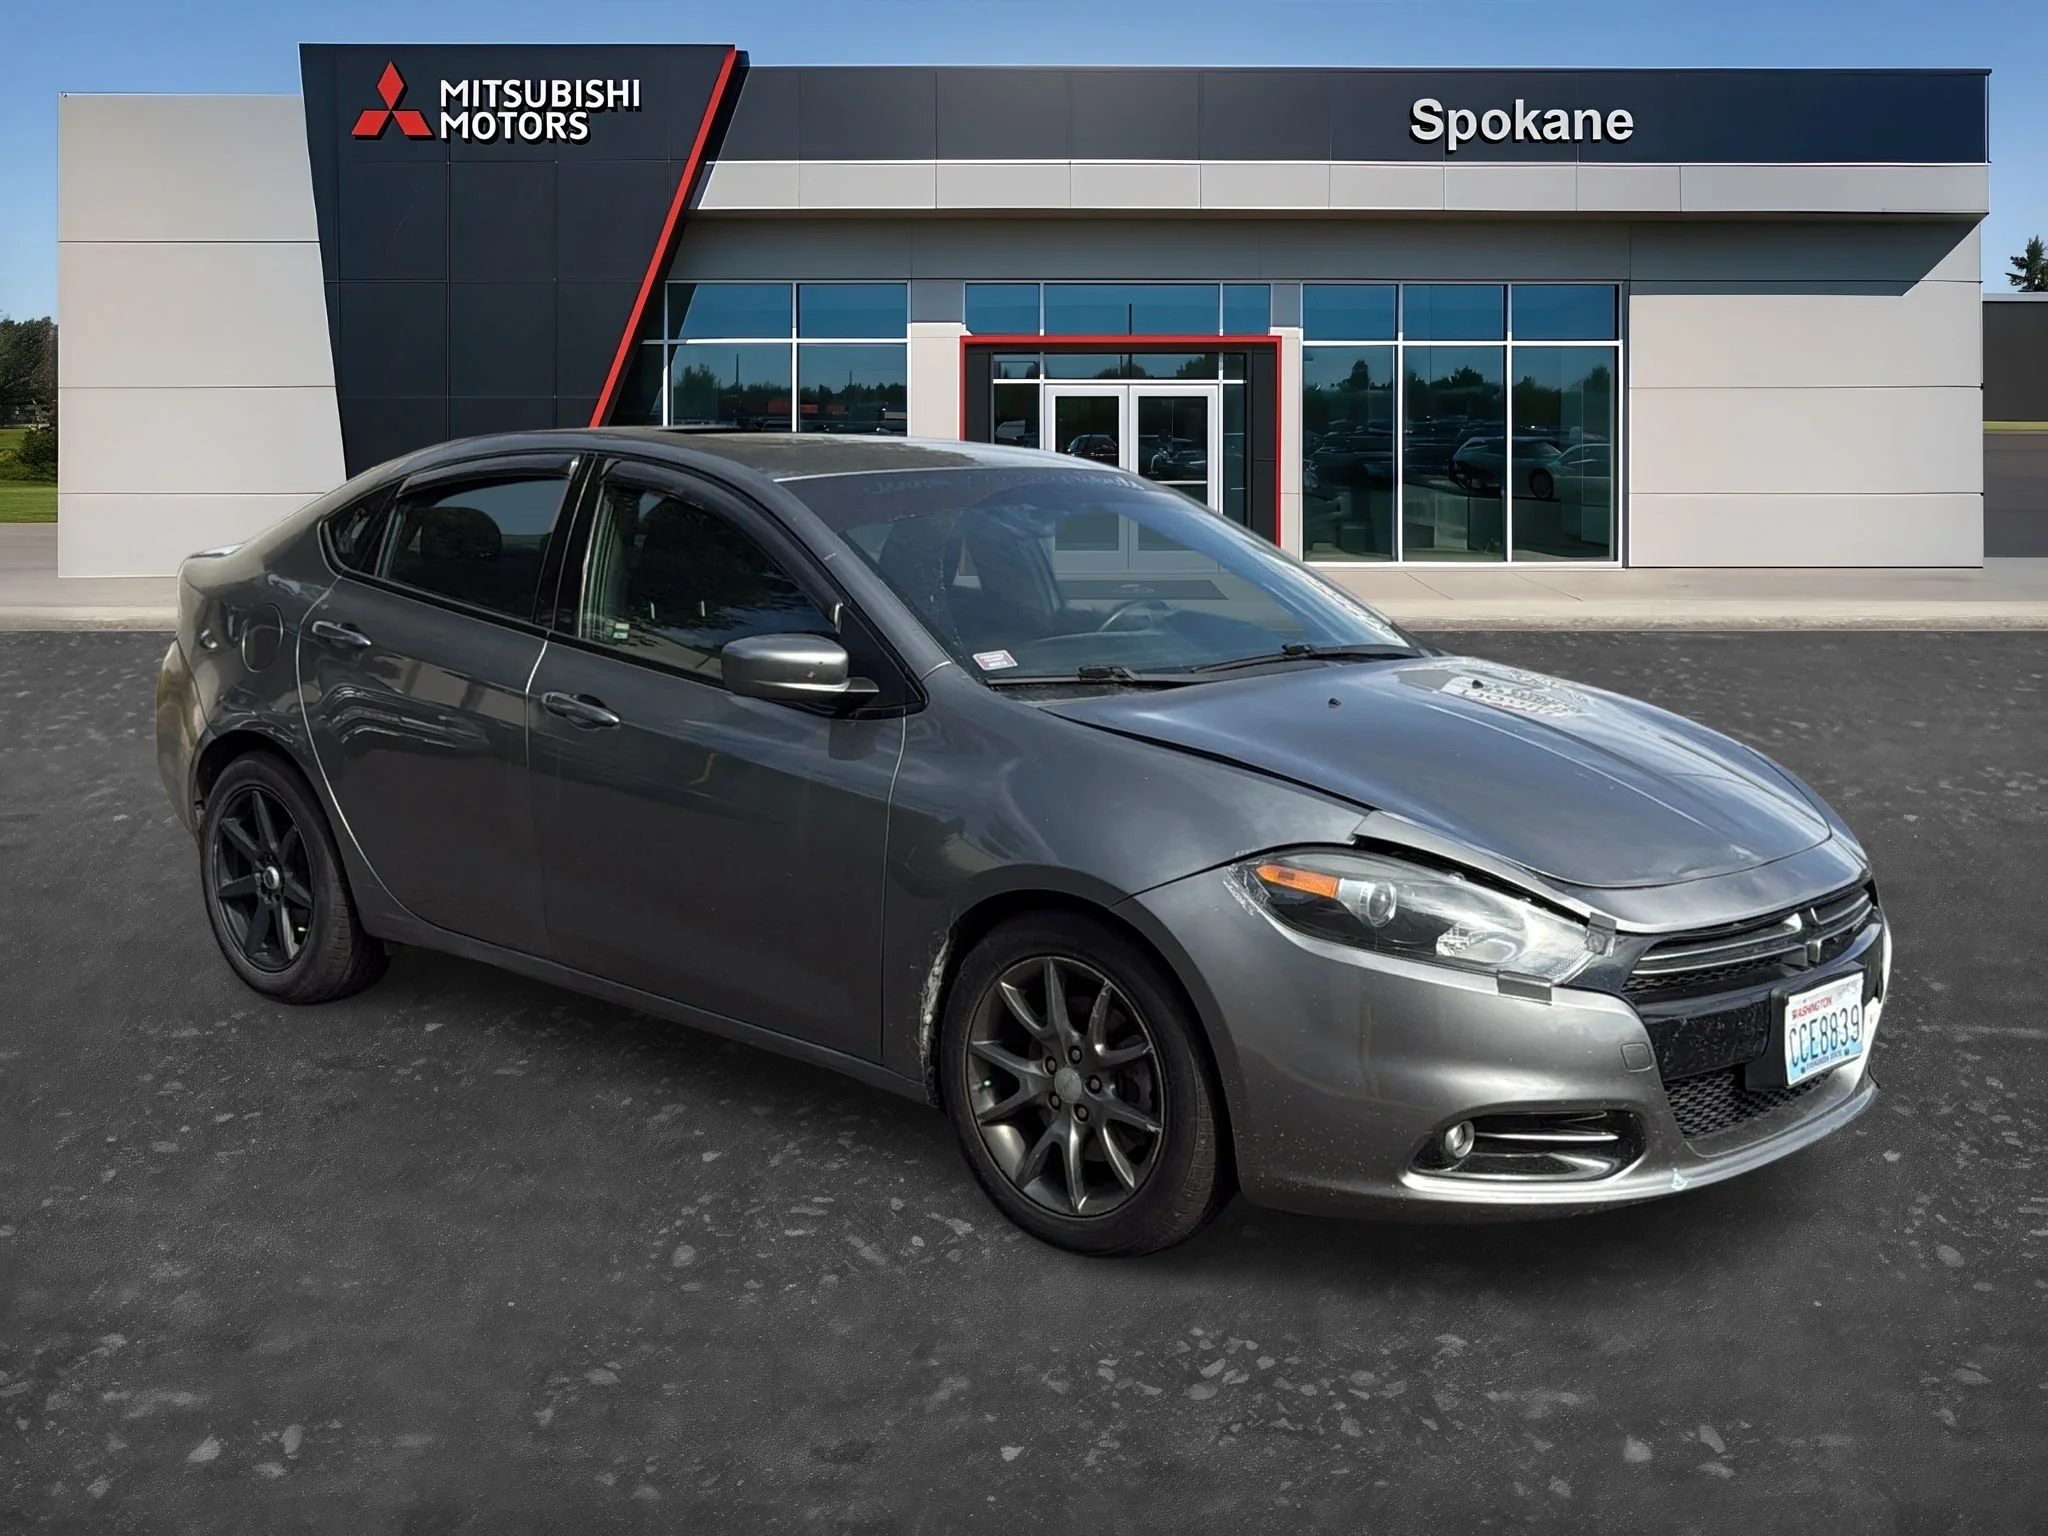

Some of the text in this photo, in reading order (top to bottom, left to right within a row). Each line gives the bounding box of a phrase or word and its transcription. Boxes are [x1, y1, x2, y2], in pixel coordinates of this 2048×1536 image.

[440, 79, 640, 108] MITSUBISHI
[440, 111, 588, 140] MOTORS
[1411, 98, 1634, 150] Spokane
[1792, 995, 1833, 1020] WASHINGTON
[1790, 1004, 1860, 1067] CCE8839
